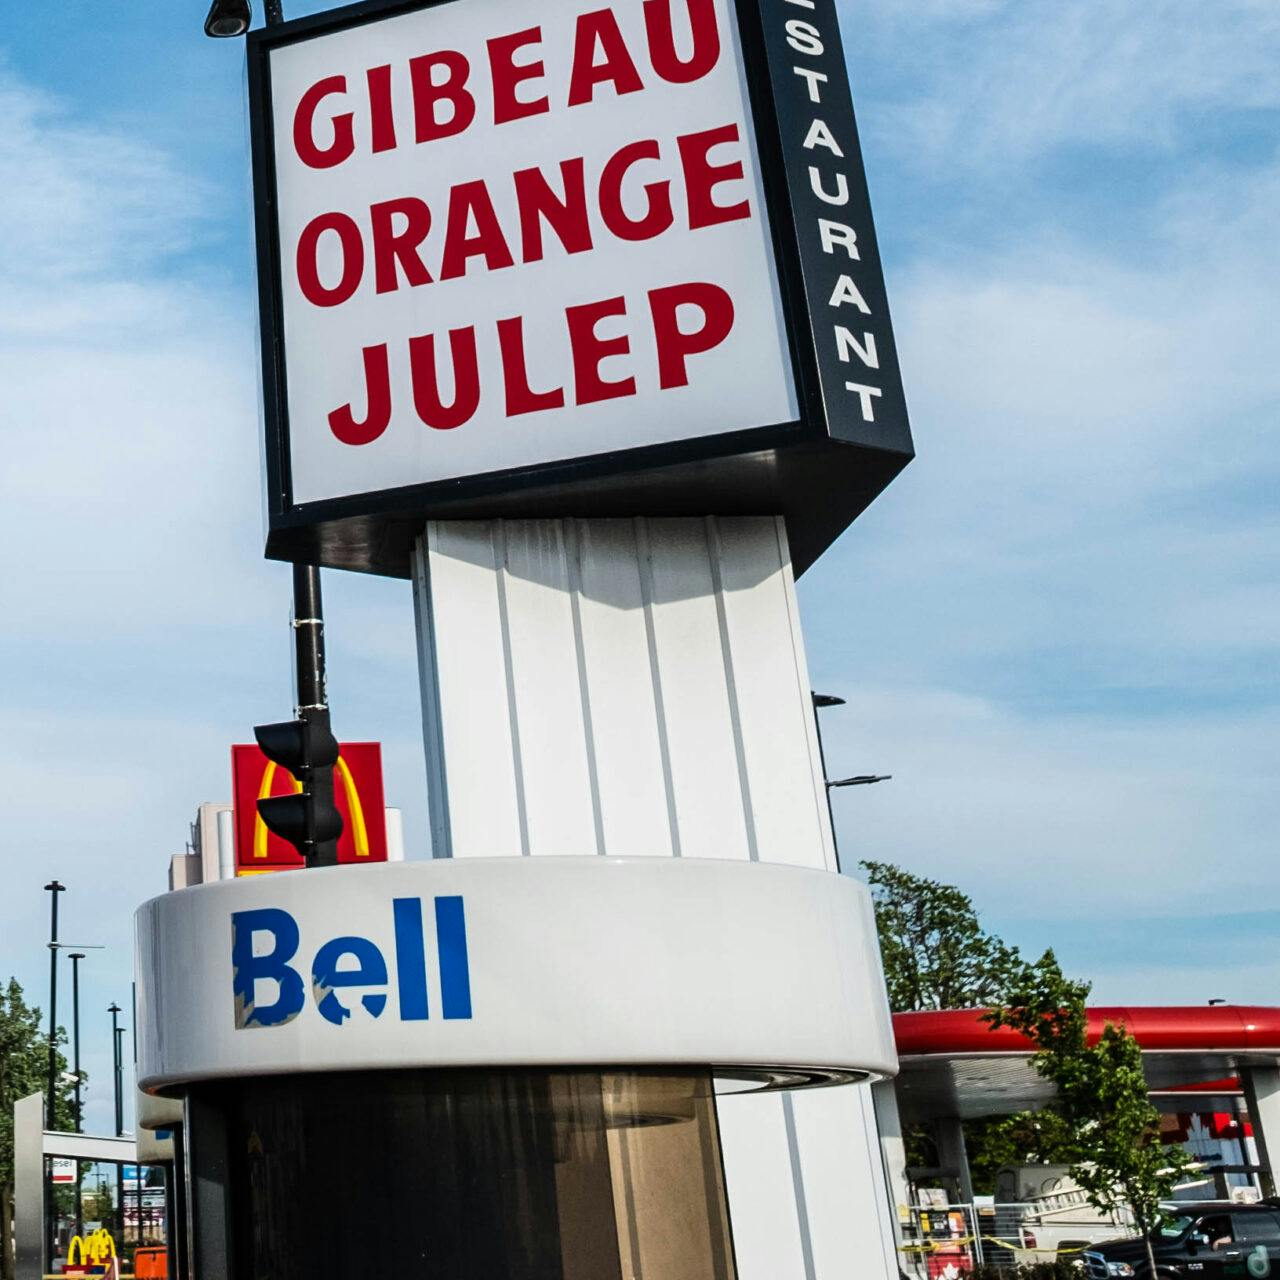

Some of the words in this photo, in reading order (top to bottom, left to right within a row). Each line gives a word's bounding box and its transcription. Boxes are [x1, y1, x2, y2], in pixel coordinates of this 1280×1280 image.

[297, 124, 751, 307] ORANGE
[328, 282, 734, 445] JULEP
[232, 896, 473, 1026] Bell
